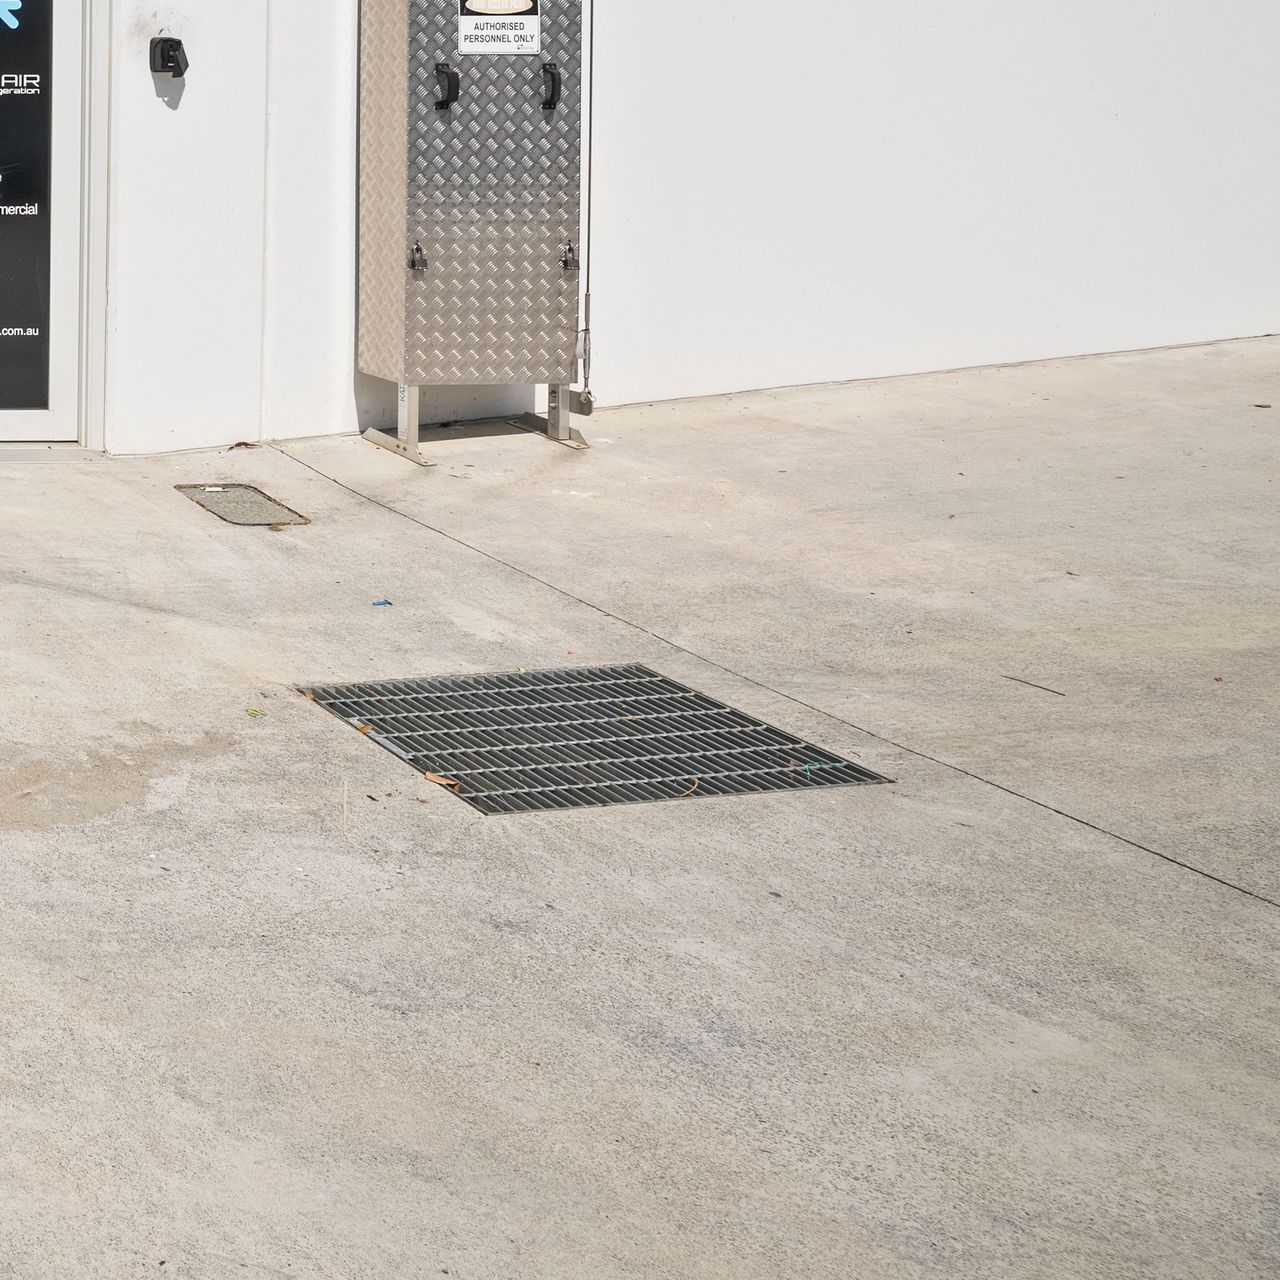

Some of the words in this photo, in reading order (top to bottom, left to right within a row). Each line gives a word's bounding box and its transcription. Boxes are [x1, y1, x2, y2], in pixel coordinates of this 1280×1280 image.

[474, 22, 525, 31] AUTHORISED
[464, 34, 512, 43] PERSONNEL
[513, 34, 535, 43] ONLY
[1, 74, 41, 87] AIR
